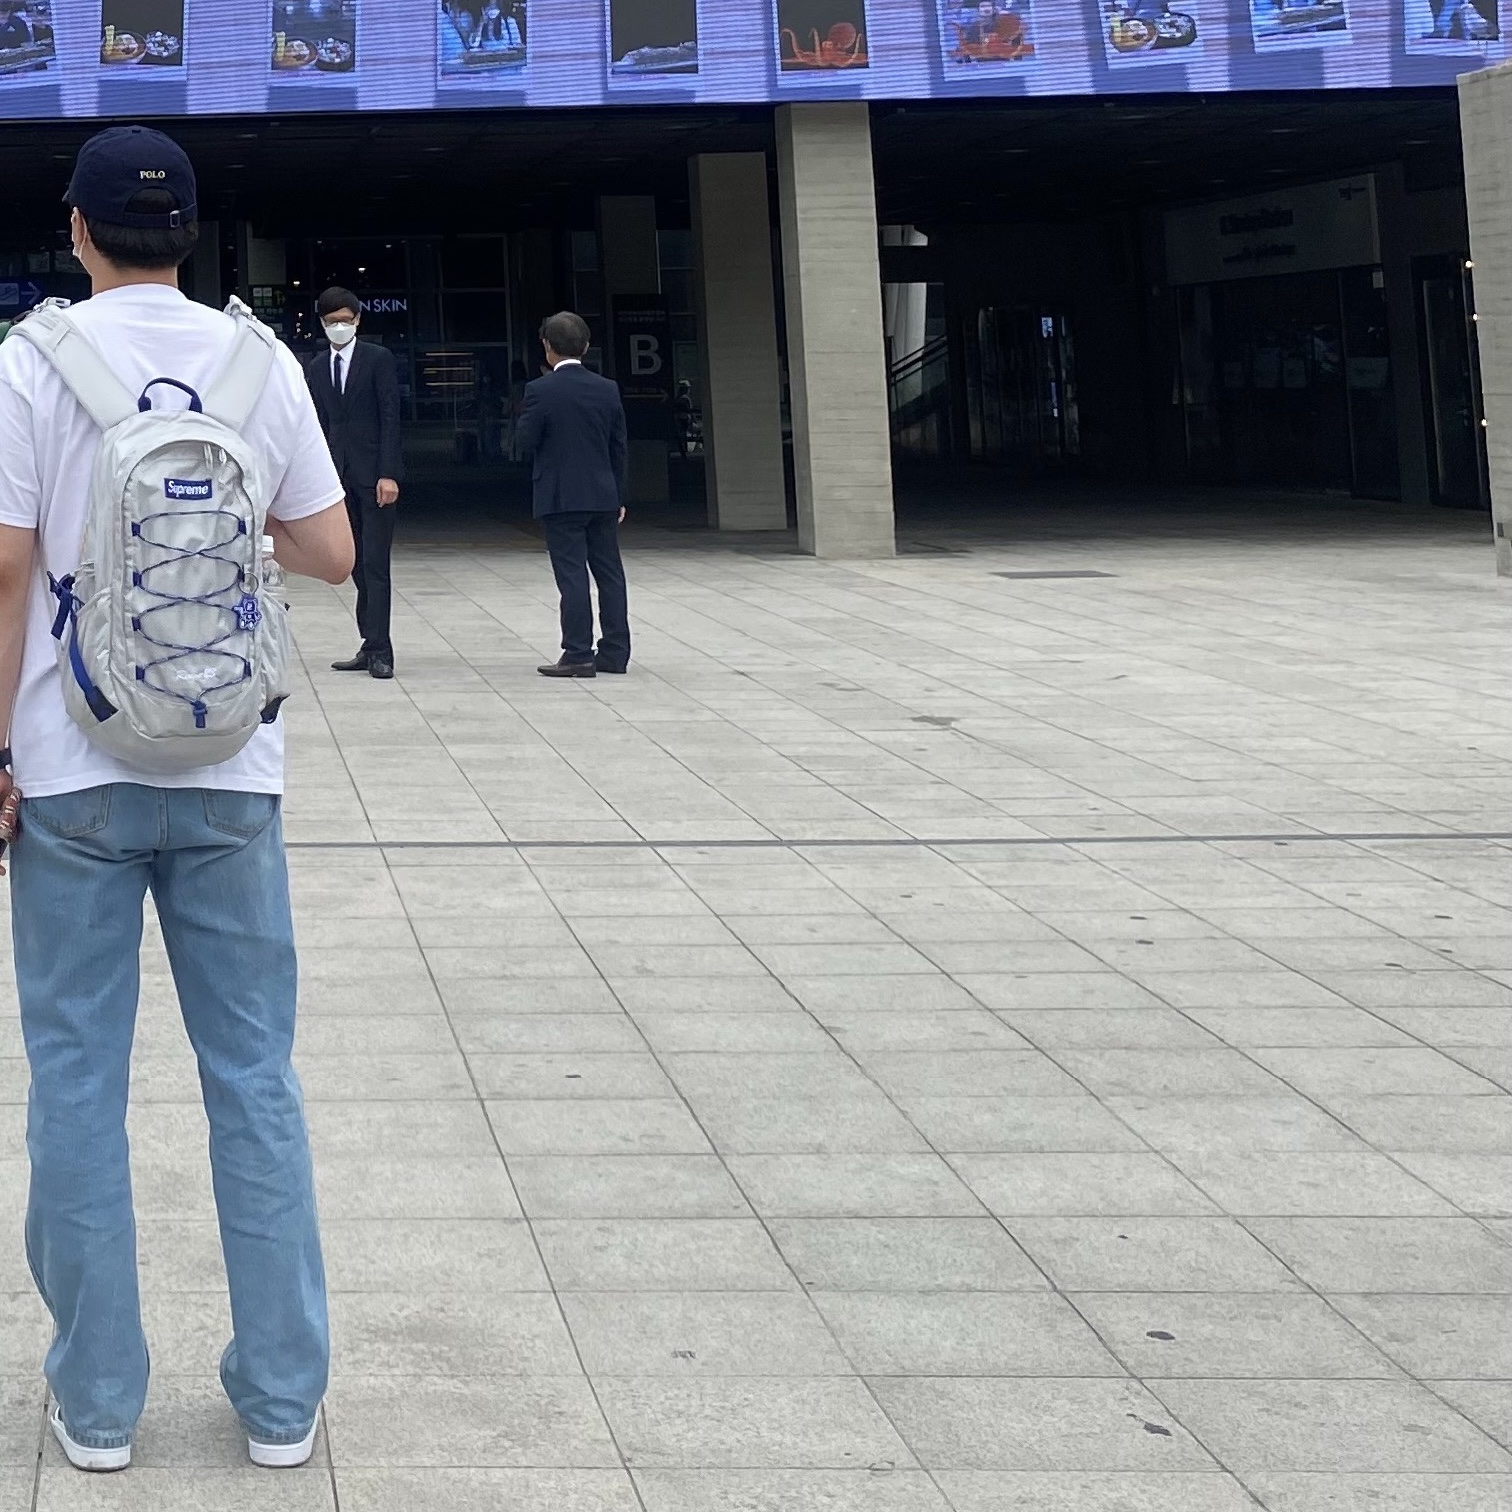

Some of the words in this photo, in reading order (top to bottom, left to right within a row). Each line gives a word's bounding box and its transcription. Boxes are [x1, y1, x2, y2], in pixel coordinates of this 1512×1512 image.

[139, 170, 166, 180] POLO
[373, 298, 407, 313] SKIN
[629, 334, 662, 375] B
[168, 480, 209, 497] Supreme
